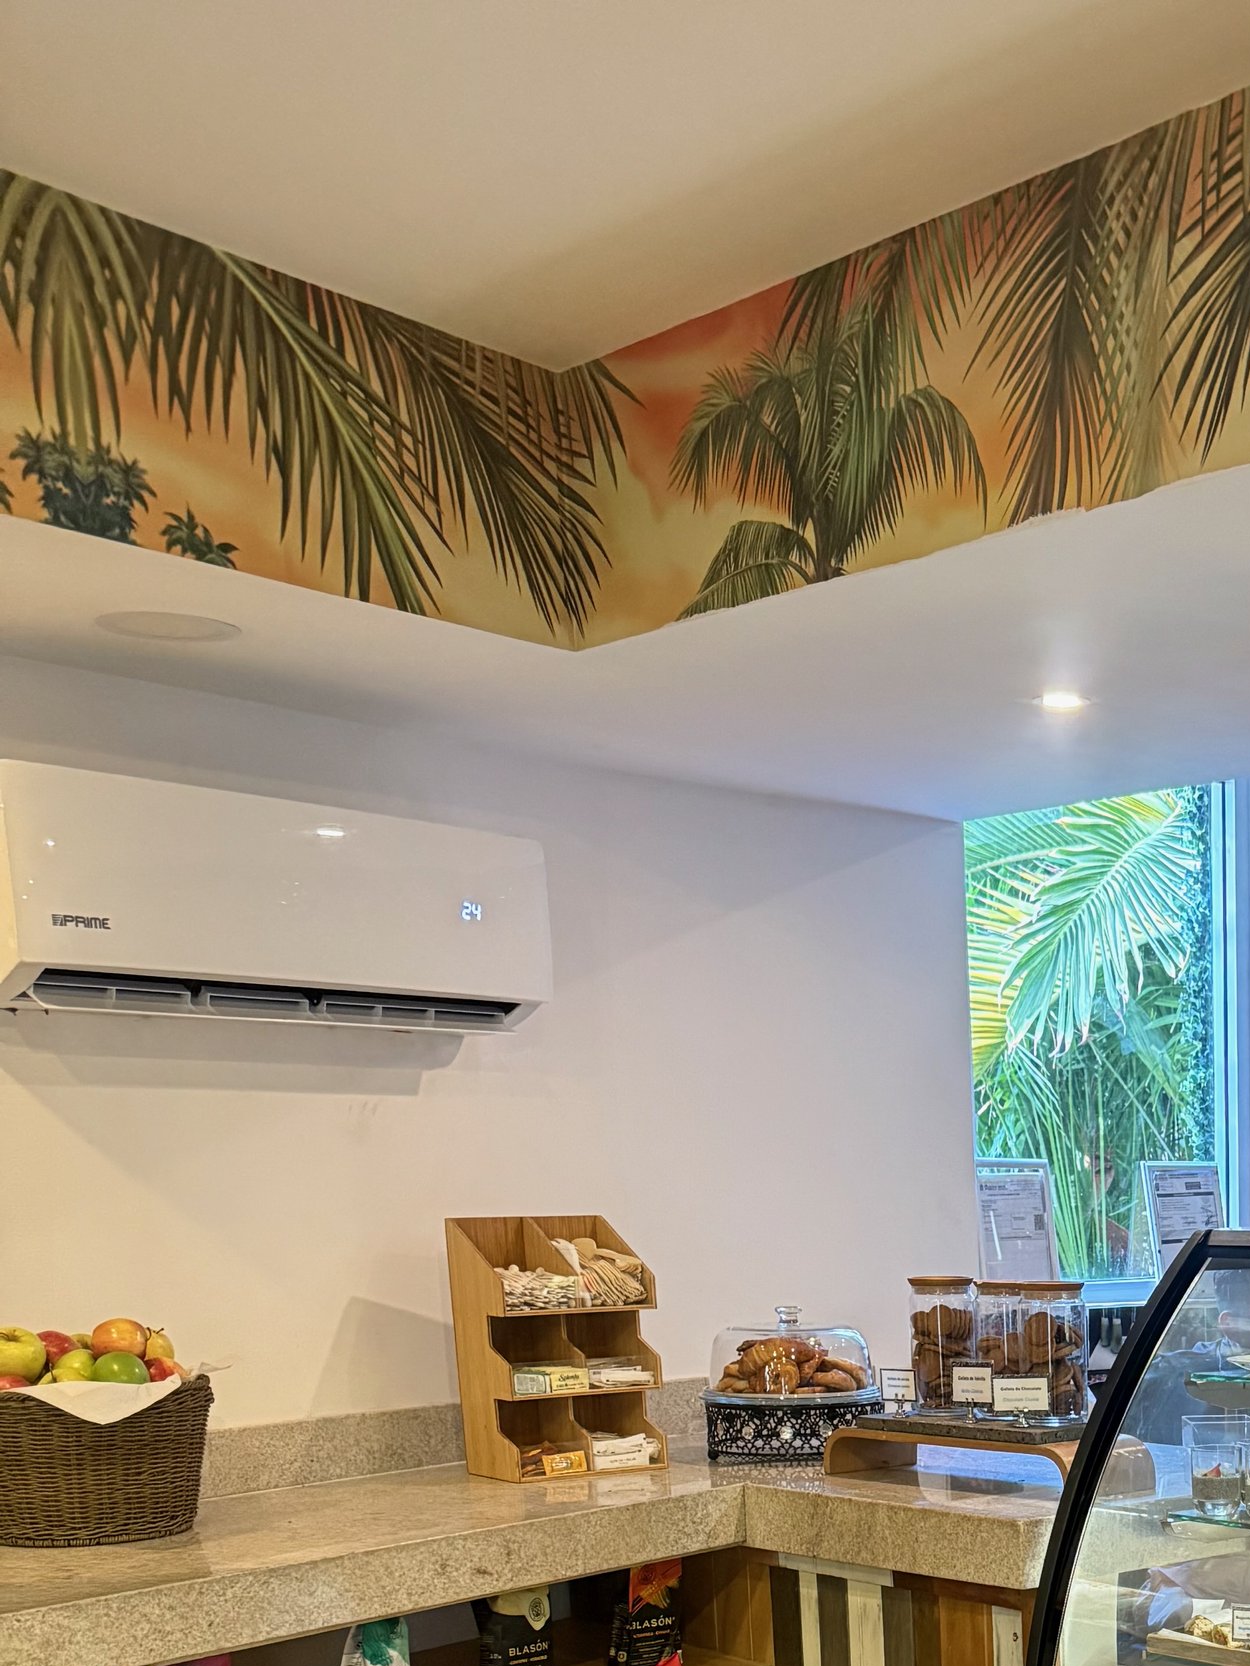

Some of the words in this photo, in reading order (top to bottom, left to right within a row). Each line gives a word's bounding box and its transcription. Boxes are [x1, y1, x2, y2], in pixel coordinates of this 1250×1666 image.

[461, 902, 481, 921] 24
[63, 914, 111, 930] PRIME
[508, 1639, 549, 1657] BLASÓN
